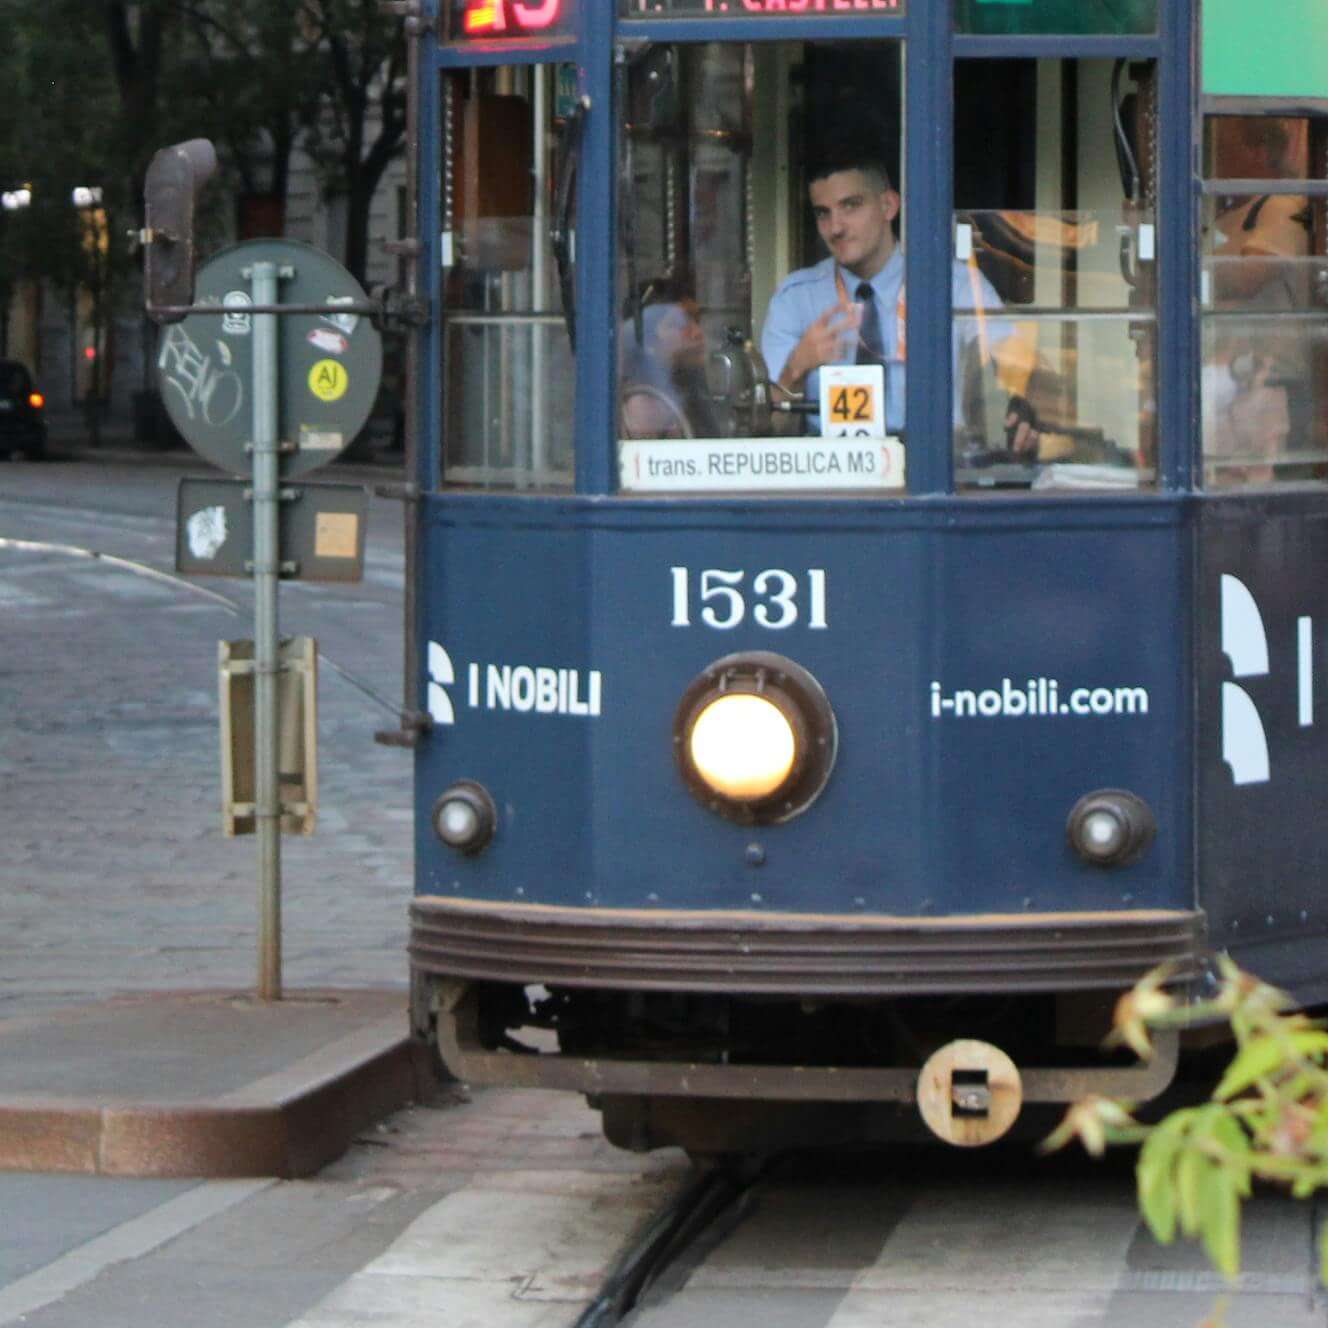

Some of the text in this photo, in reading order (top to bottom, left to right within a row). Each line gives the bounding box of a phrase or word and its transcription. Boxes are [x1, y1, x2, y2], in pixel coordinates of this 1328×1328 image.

[831, 388, 871, 421] 42
[647, 450, 876, 477] trans. REPUBBLICA M3
[670, 566, 829, 631] 1531
[468, 662, 603, 717] I NOBILI
[1296, 615, 1314, 727] I
[929, 676, 1149, 718] i-nobili.com
